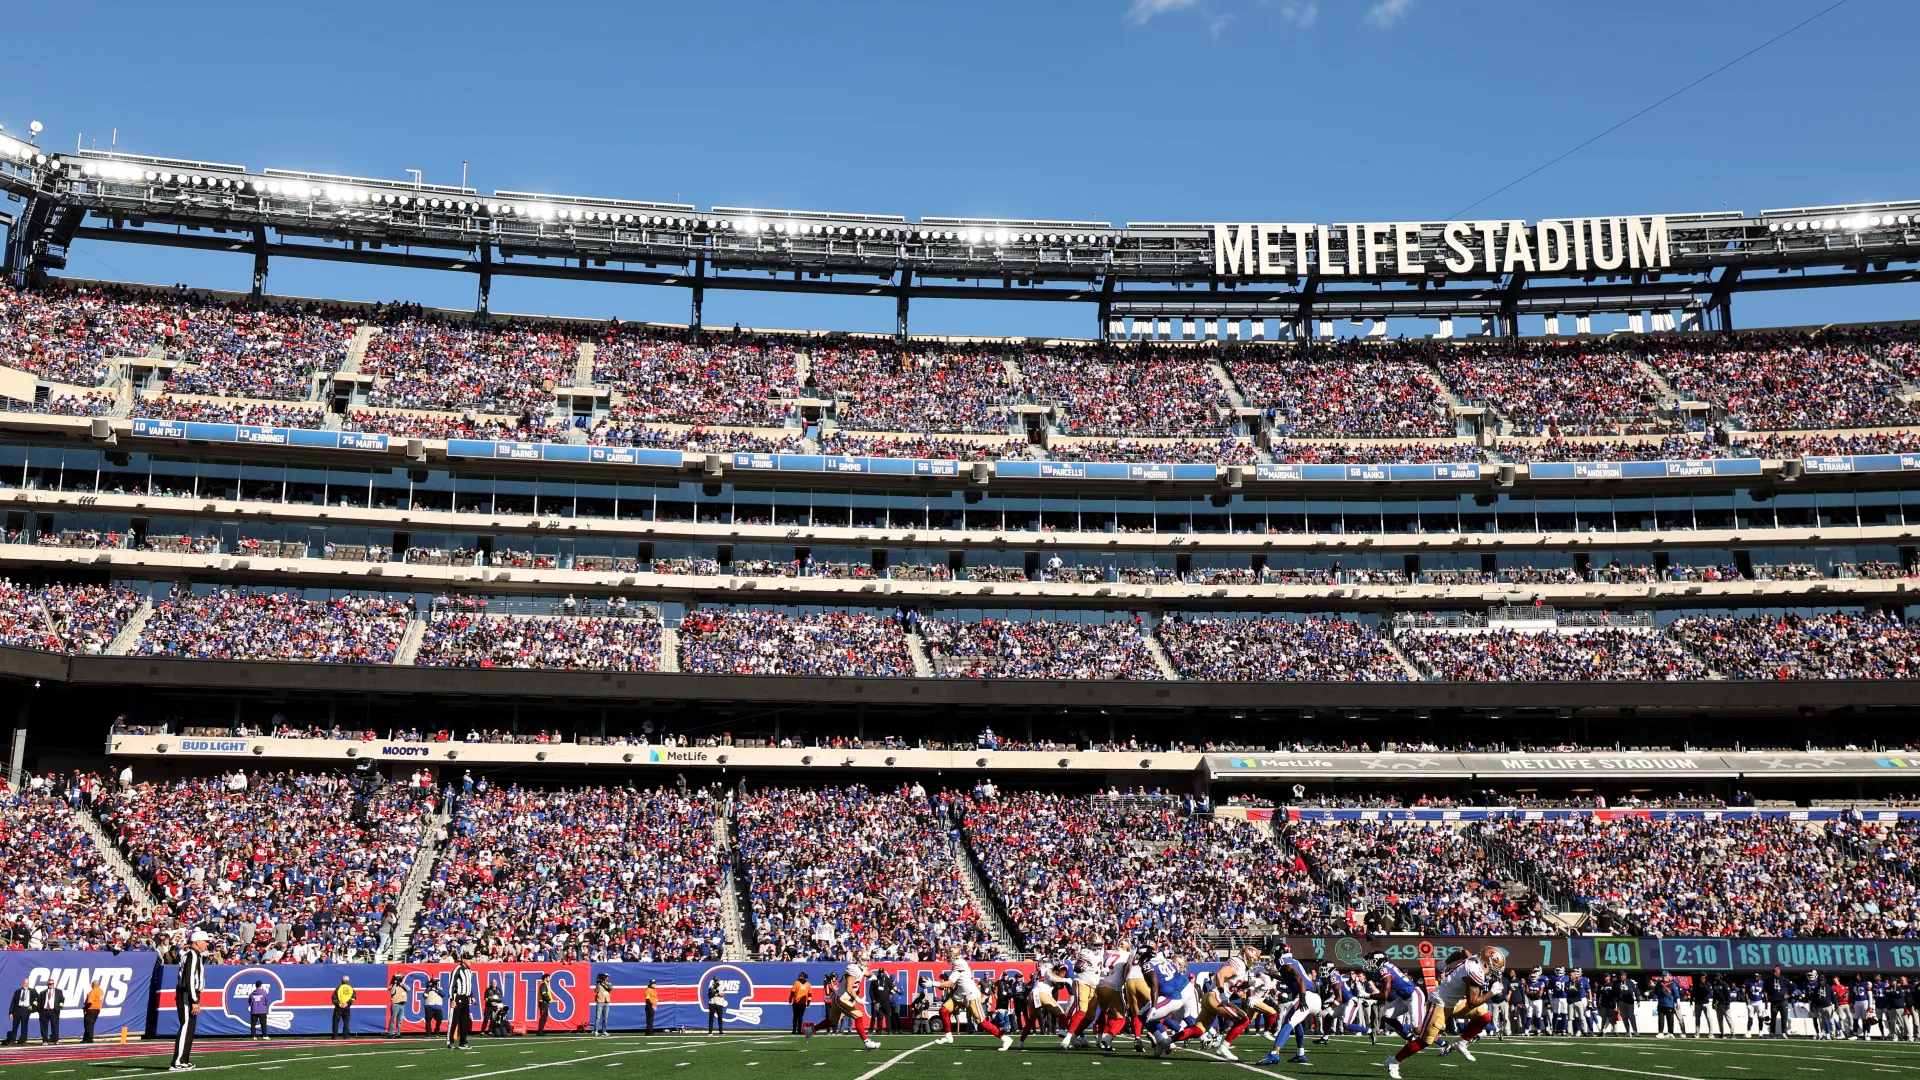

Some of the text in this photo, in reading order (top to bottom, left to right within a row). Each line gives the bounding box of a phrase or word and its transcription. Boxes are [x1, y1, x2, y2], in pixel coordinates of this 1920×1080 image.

[1215, 217, 1670, 274] METLIFE STADIUM
[134, 422, 182, 436] 10 VAN PELT
[239, 430, 284, 443] 13 JENNINGS
[342, 436, 383, 449] 75 MARTIN
[511, 450, 538, 458] BARNES
[594, 450, 633, 462] 53 CARSON
[751, 460, 772, 468] YOUNG
[828, 460, 861, 471] 11 SIMMS
[918, 463, 954, 474] 56 TAYLOR
[1669, 464, 1712, 475] 27 HAMPTON
[1806, 460, 1851, 471] 92 STRAHAN
[1133, 467, 1142, 475] 20
[1258, 468, 1268, 476] 70
[1351, 468, 1360, 476] 58
[1451, 470, 1475, 478] BAVARO
[1577, 466, 1587, 474] 24
[183, 741, 246, 752] BUD LIGHT
[382, 747, 429, 756] MOODY'S
[667, 752, 707, 761] MetLife
[1500, 760, 1699, 769] METLIFE STADIUM
[1539, 940, 1552, 966] 7
[1604, 943, 1630, 964] 40
[1675, 944, 1717, 965] 2:10
[1737, 943, 1870, 966] 1ST QUARTER
[1556, 982, 1565, 991] 91
